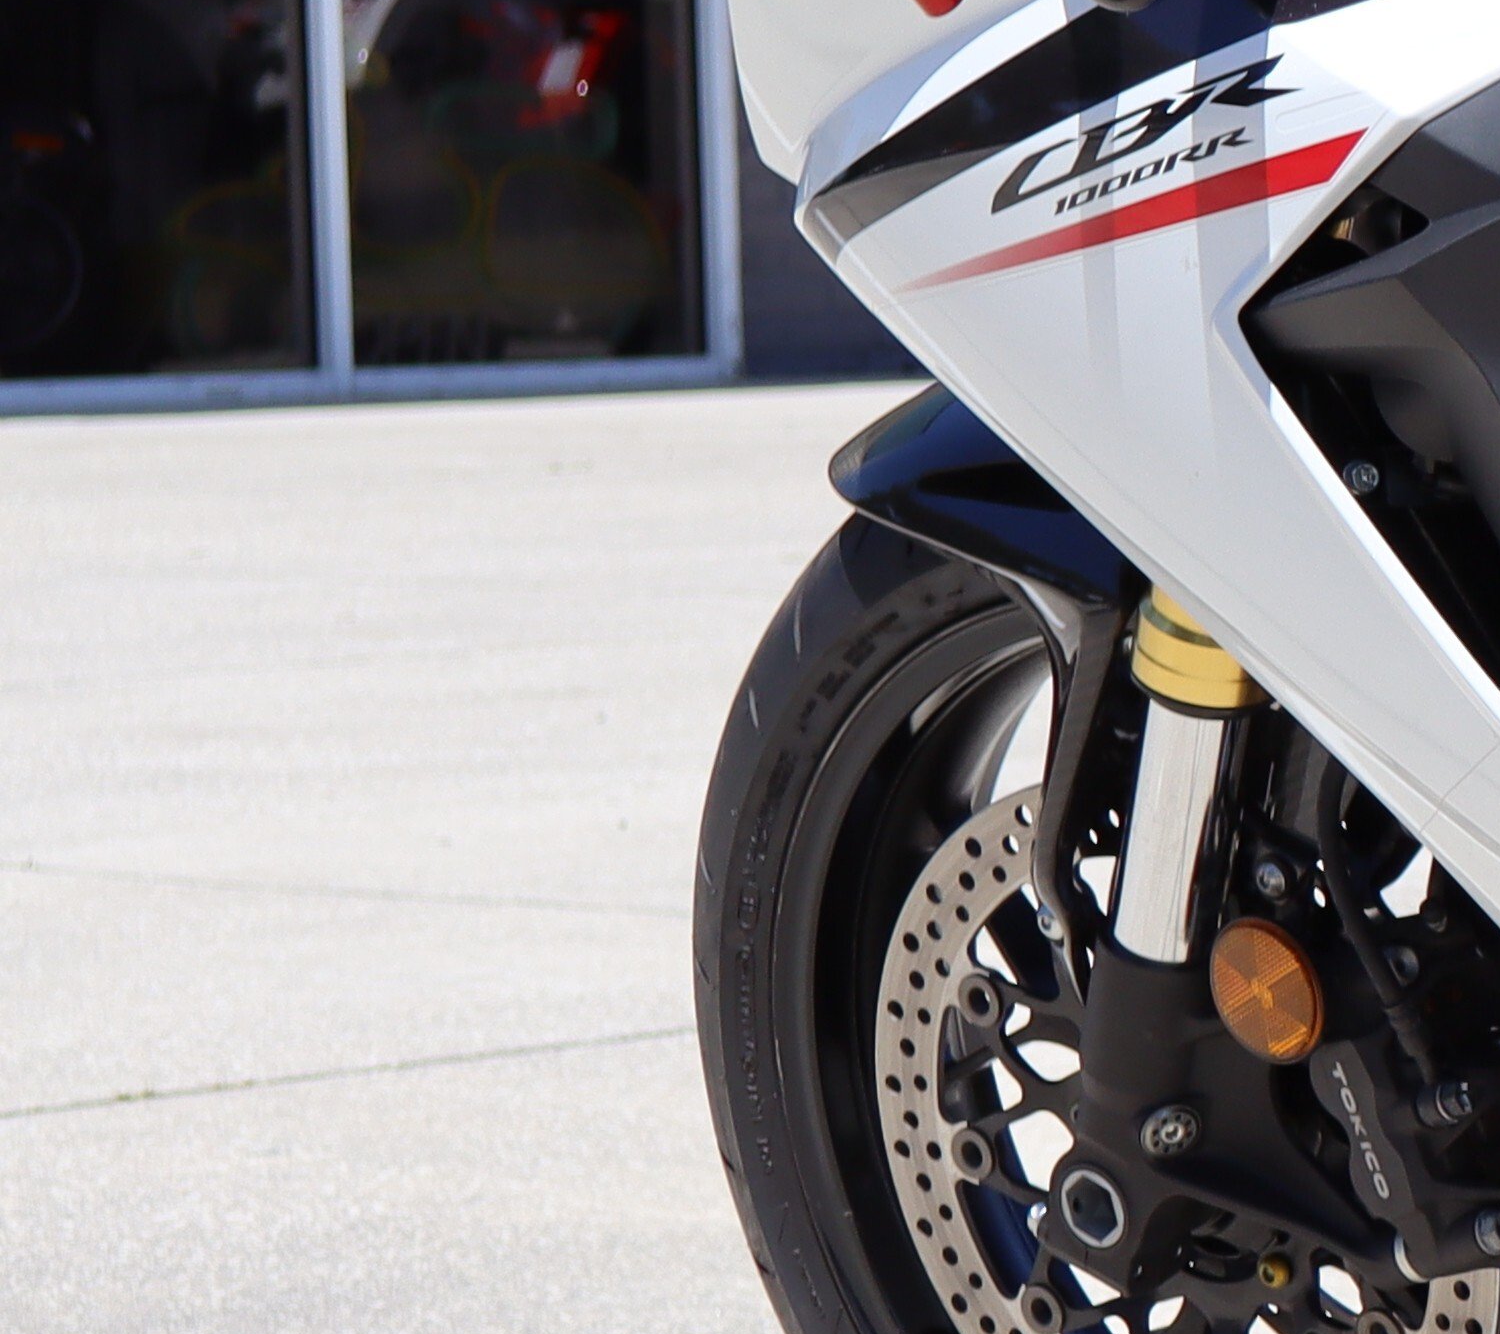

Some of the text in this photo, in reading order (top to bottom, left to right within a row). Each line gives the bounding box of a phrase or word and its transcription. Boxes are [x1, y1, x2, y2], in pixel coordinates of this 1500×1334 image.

[990, 53, 1302, 215] CBR
[1053, 127, 1253, 215] 1000RR
[1330, 1061, 1391, 1201] TOKICO
